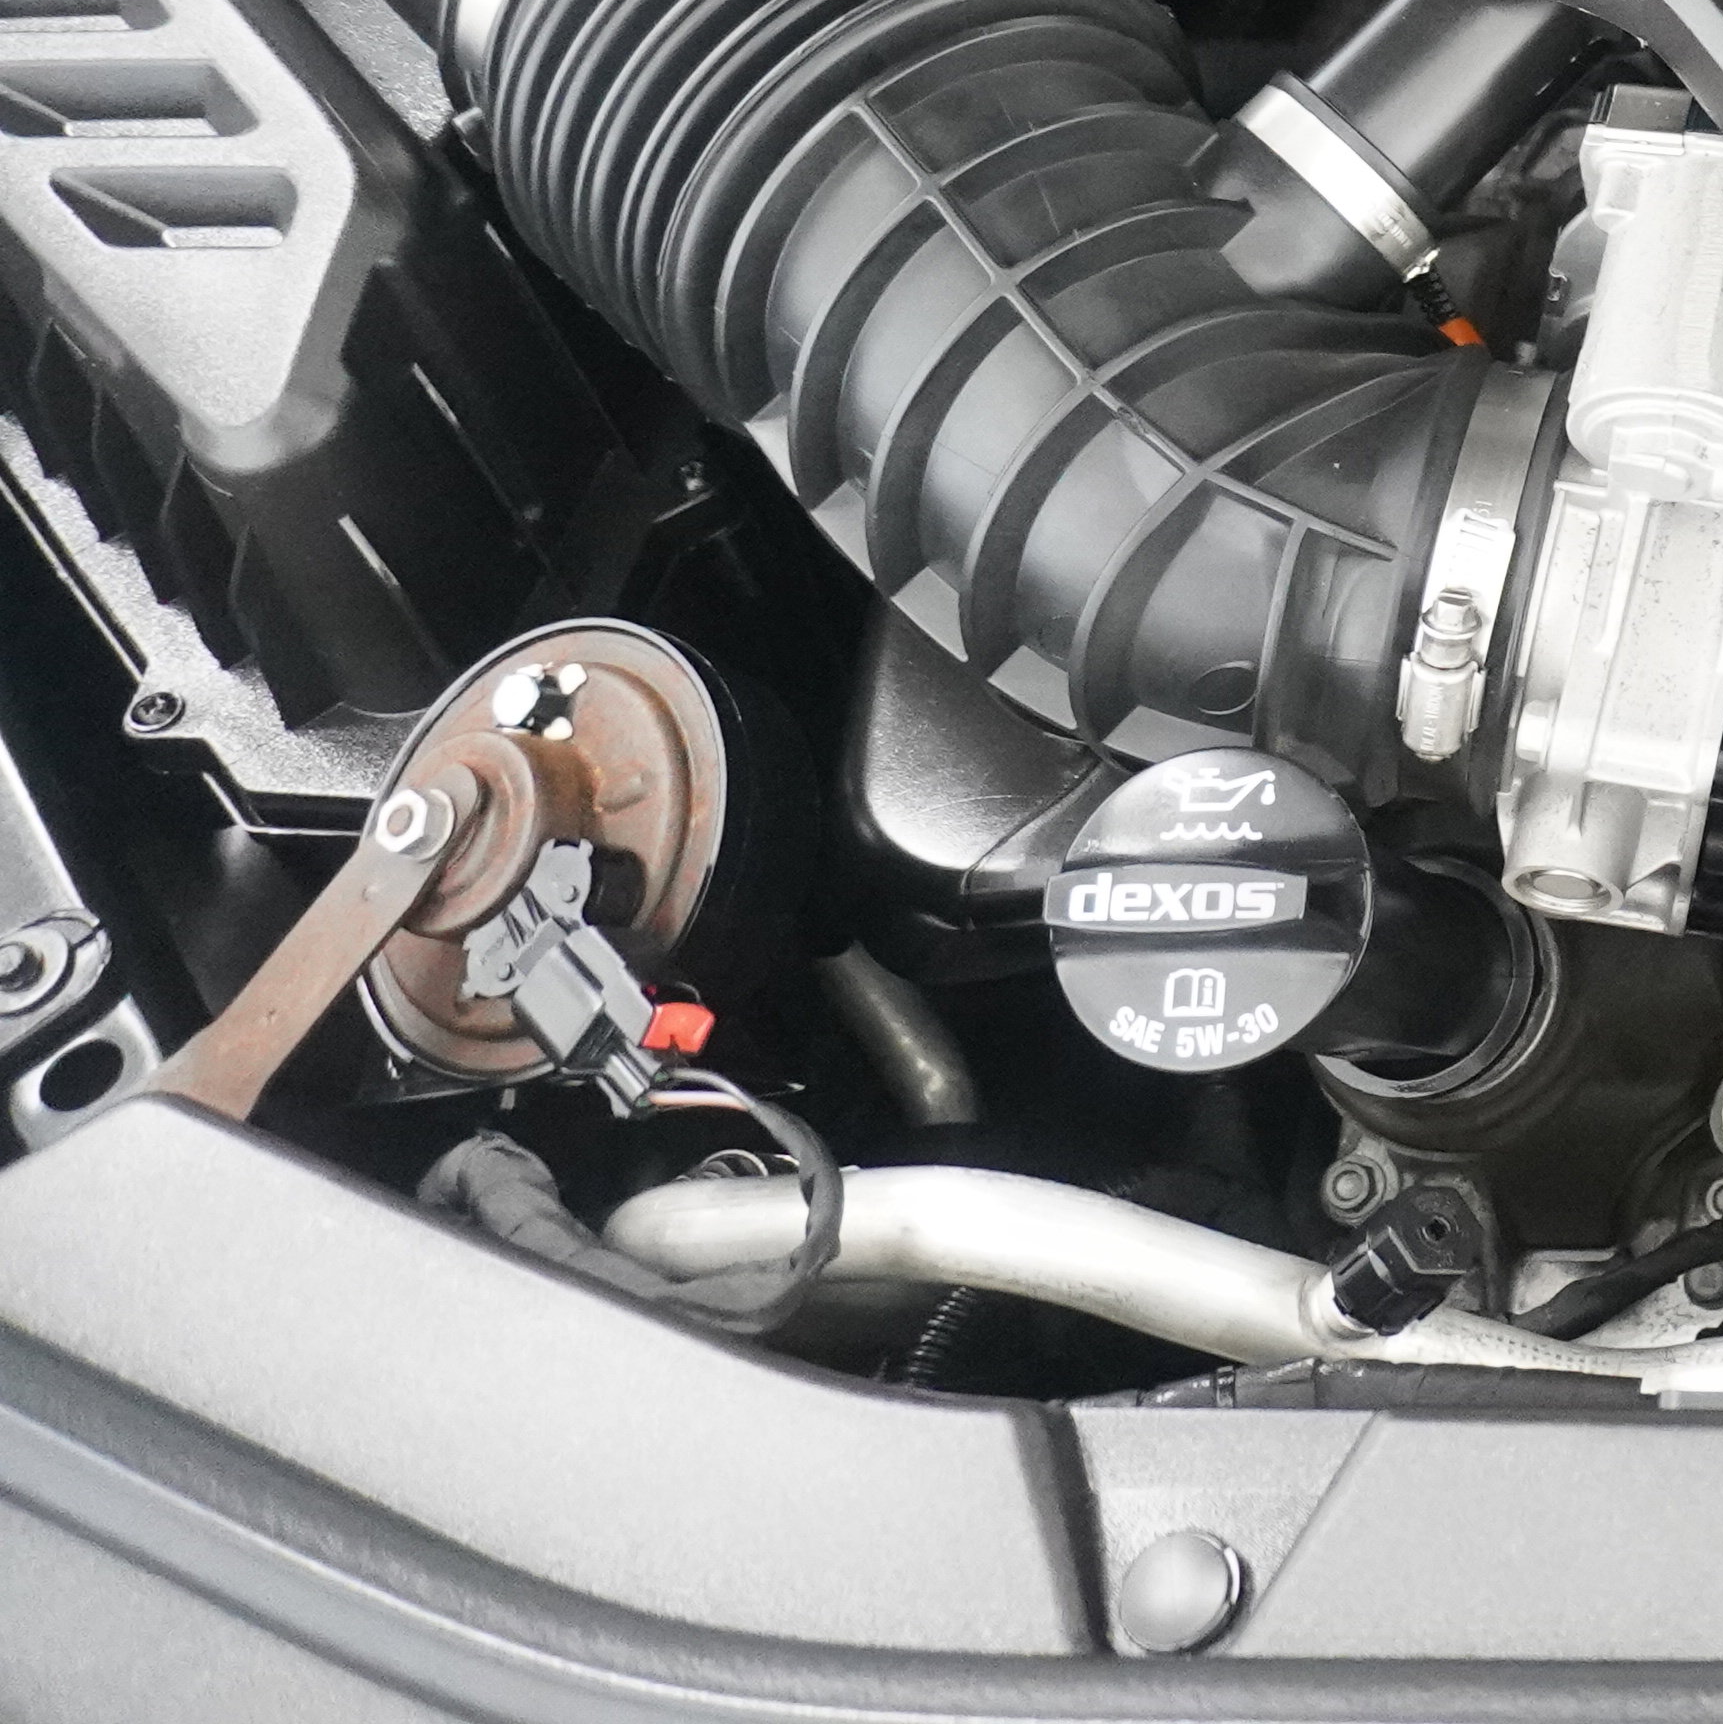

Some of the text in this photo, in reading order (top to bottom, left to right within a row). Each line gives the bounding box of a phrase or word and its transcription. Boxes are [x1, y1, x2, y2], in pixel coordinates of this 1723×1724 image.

[1067, 872, 1278, 923] dexos
[1108, 1002, 1280, 1058] SAE 5W-30
